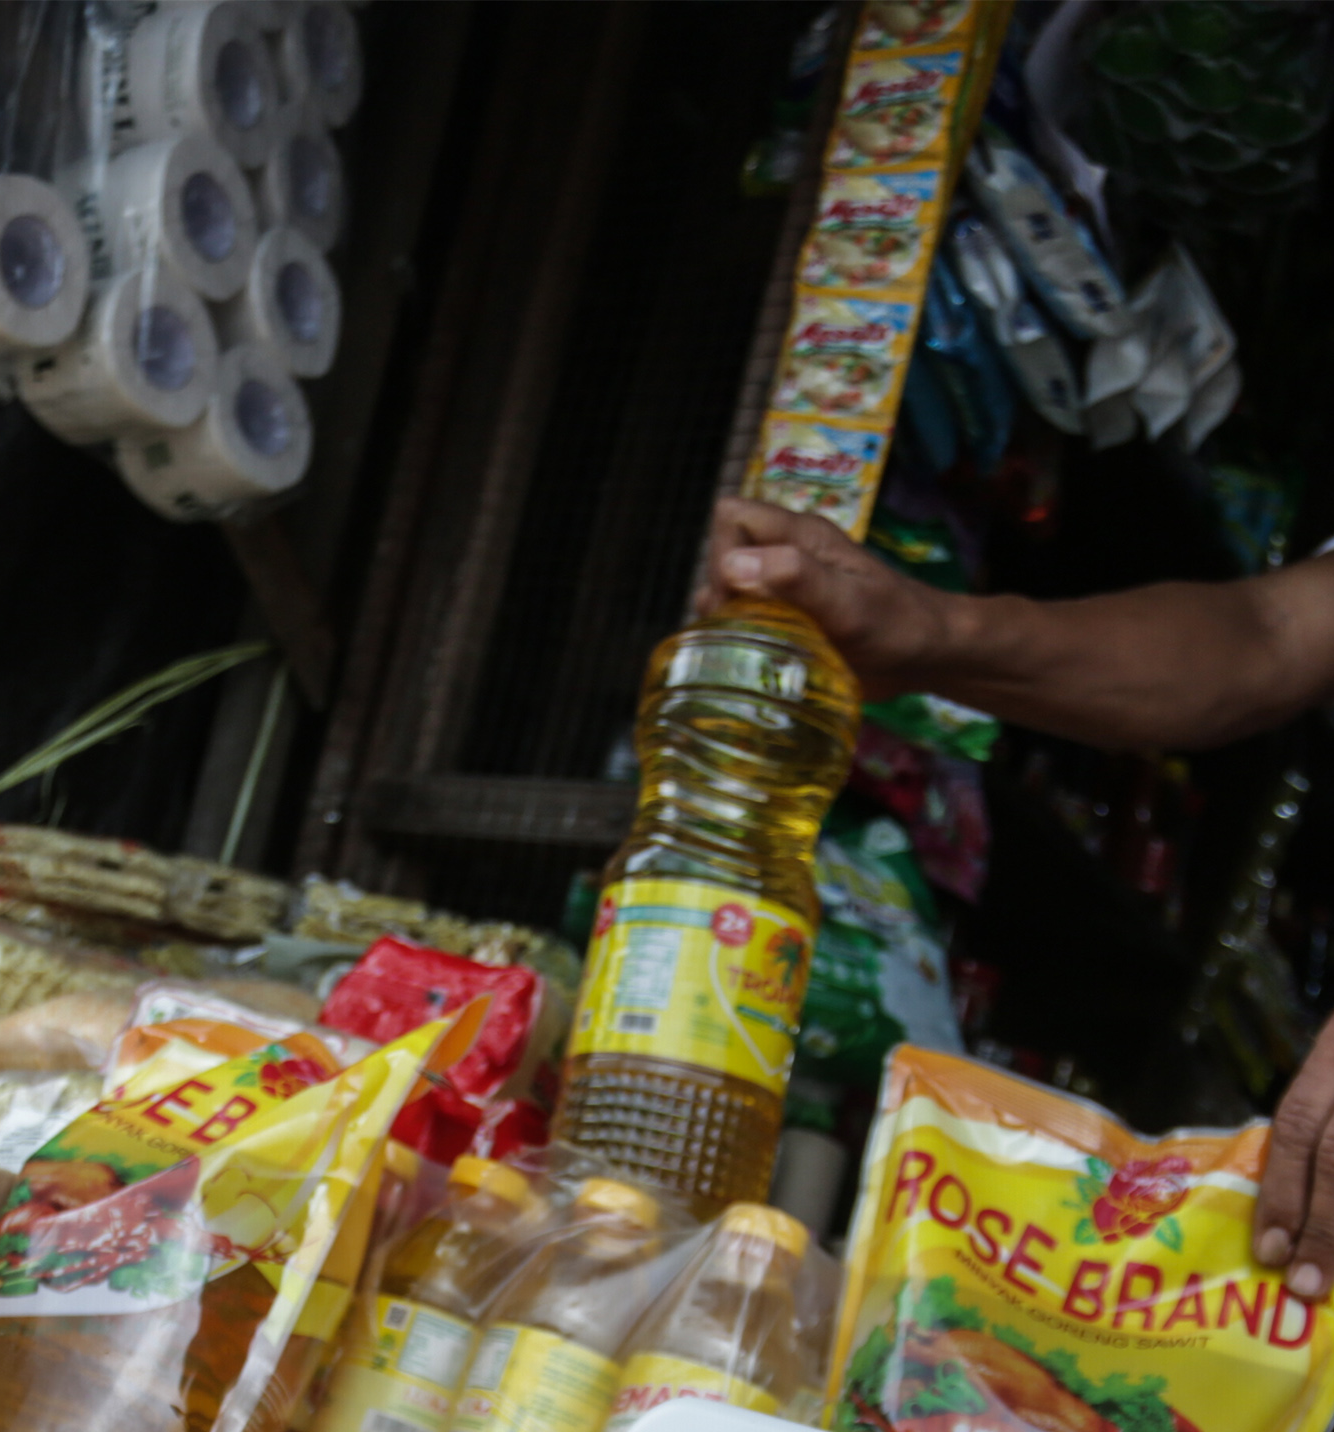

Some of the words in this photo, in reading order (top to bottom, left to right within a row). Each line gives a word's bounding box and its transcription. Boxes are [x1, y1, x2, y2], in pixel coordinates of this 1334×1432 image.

[885, 1150, 1058, 1297] ROSE
[1062, 1258, 1316, 1351] BRAND
[1032, 1306, 1129, 1350] GORENG
[1136, 1334, 1212, 1350] SAWIT
